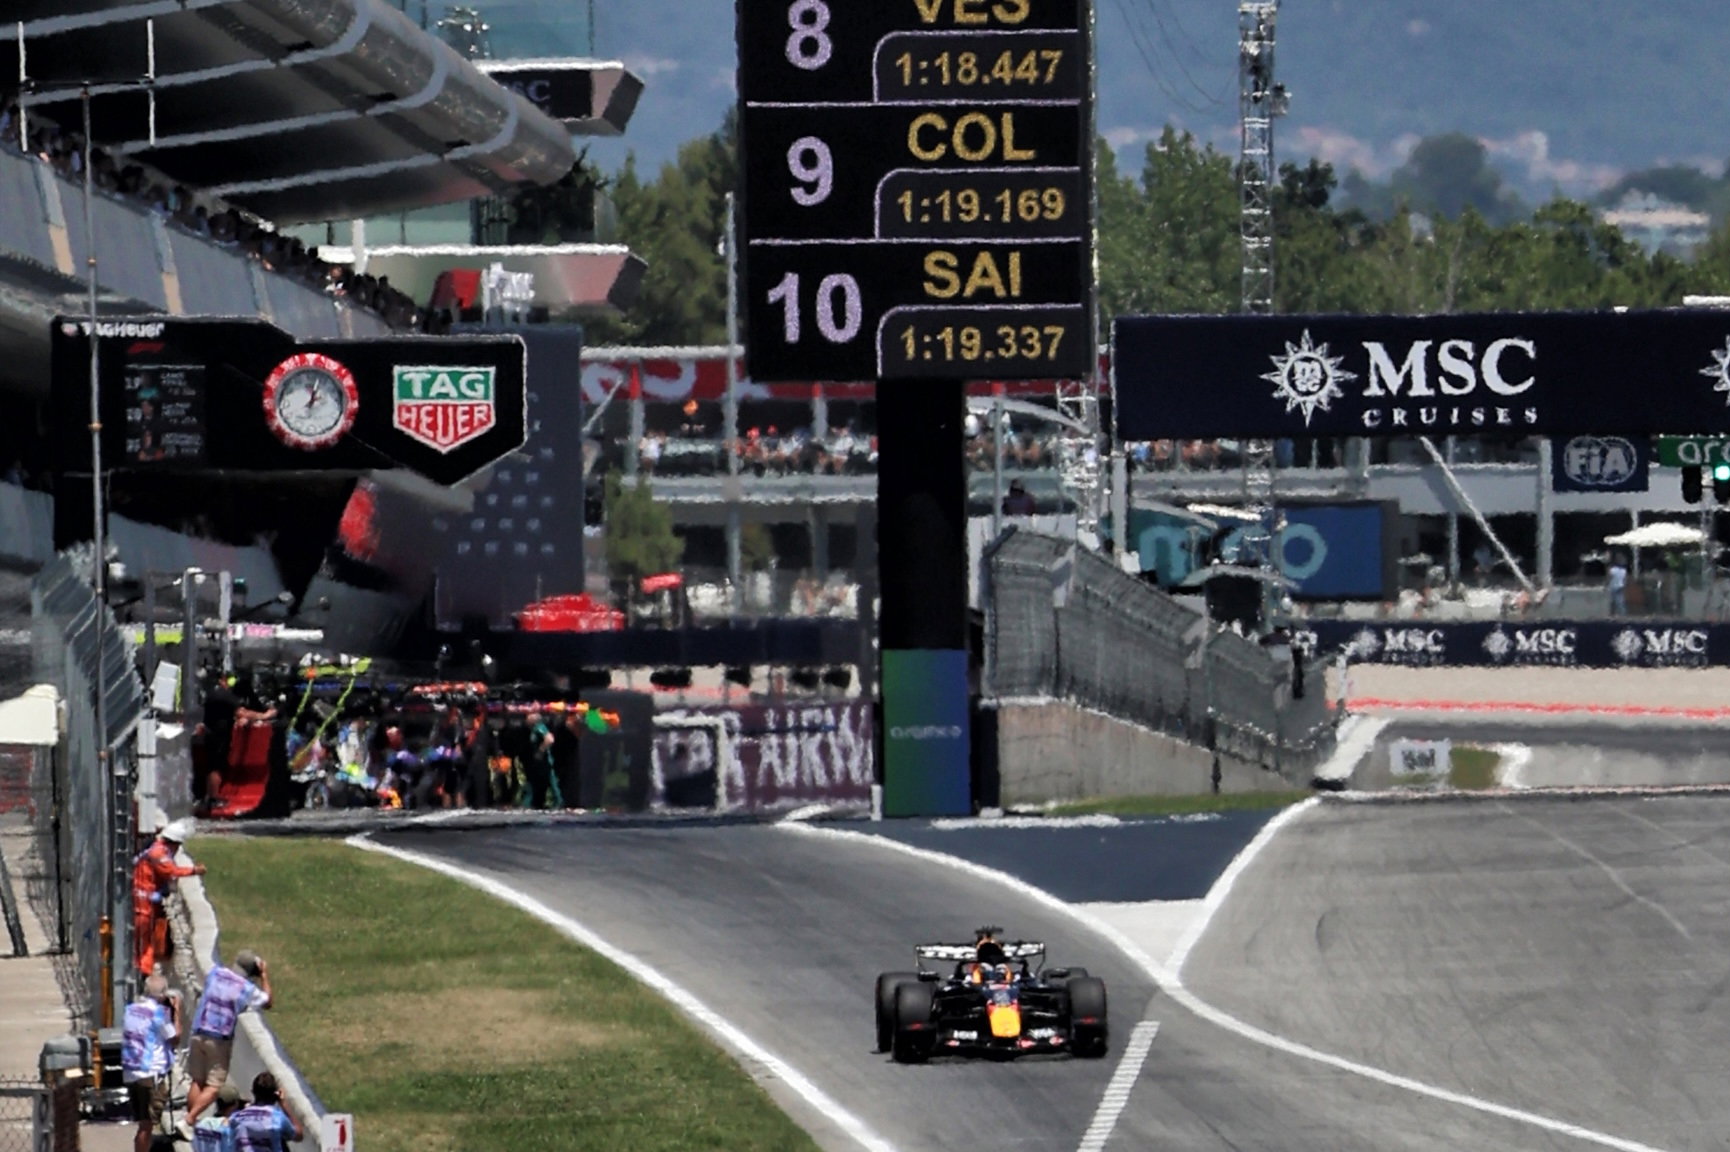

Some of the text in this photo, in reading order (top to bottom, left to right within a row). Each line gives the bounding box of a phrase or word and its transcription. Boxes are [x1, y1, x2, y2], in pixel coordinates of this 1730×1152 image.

[786, 0, 832, 70] 8
[896, 51, 1062, 86] 1:18.447
[907, 112, 1035, 161] COL
[787, 136, 833, 206] 9
[897, 188, 1065, 223] 1:19.169
[923, 251, 1021, 298] SAI
[767, 272, 862, 343] 10
[901, 325, 1065, 361] 1:19.337
[402, 373, 485, 399] TAG
[1362, 338, 1536, 396] MSC
[401, 405, 489, 444] HEUER
[1362, 407, 1538, 427] CRUISES
